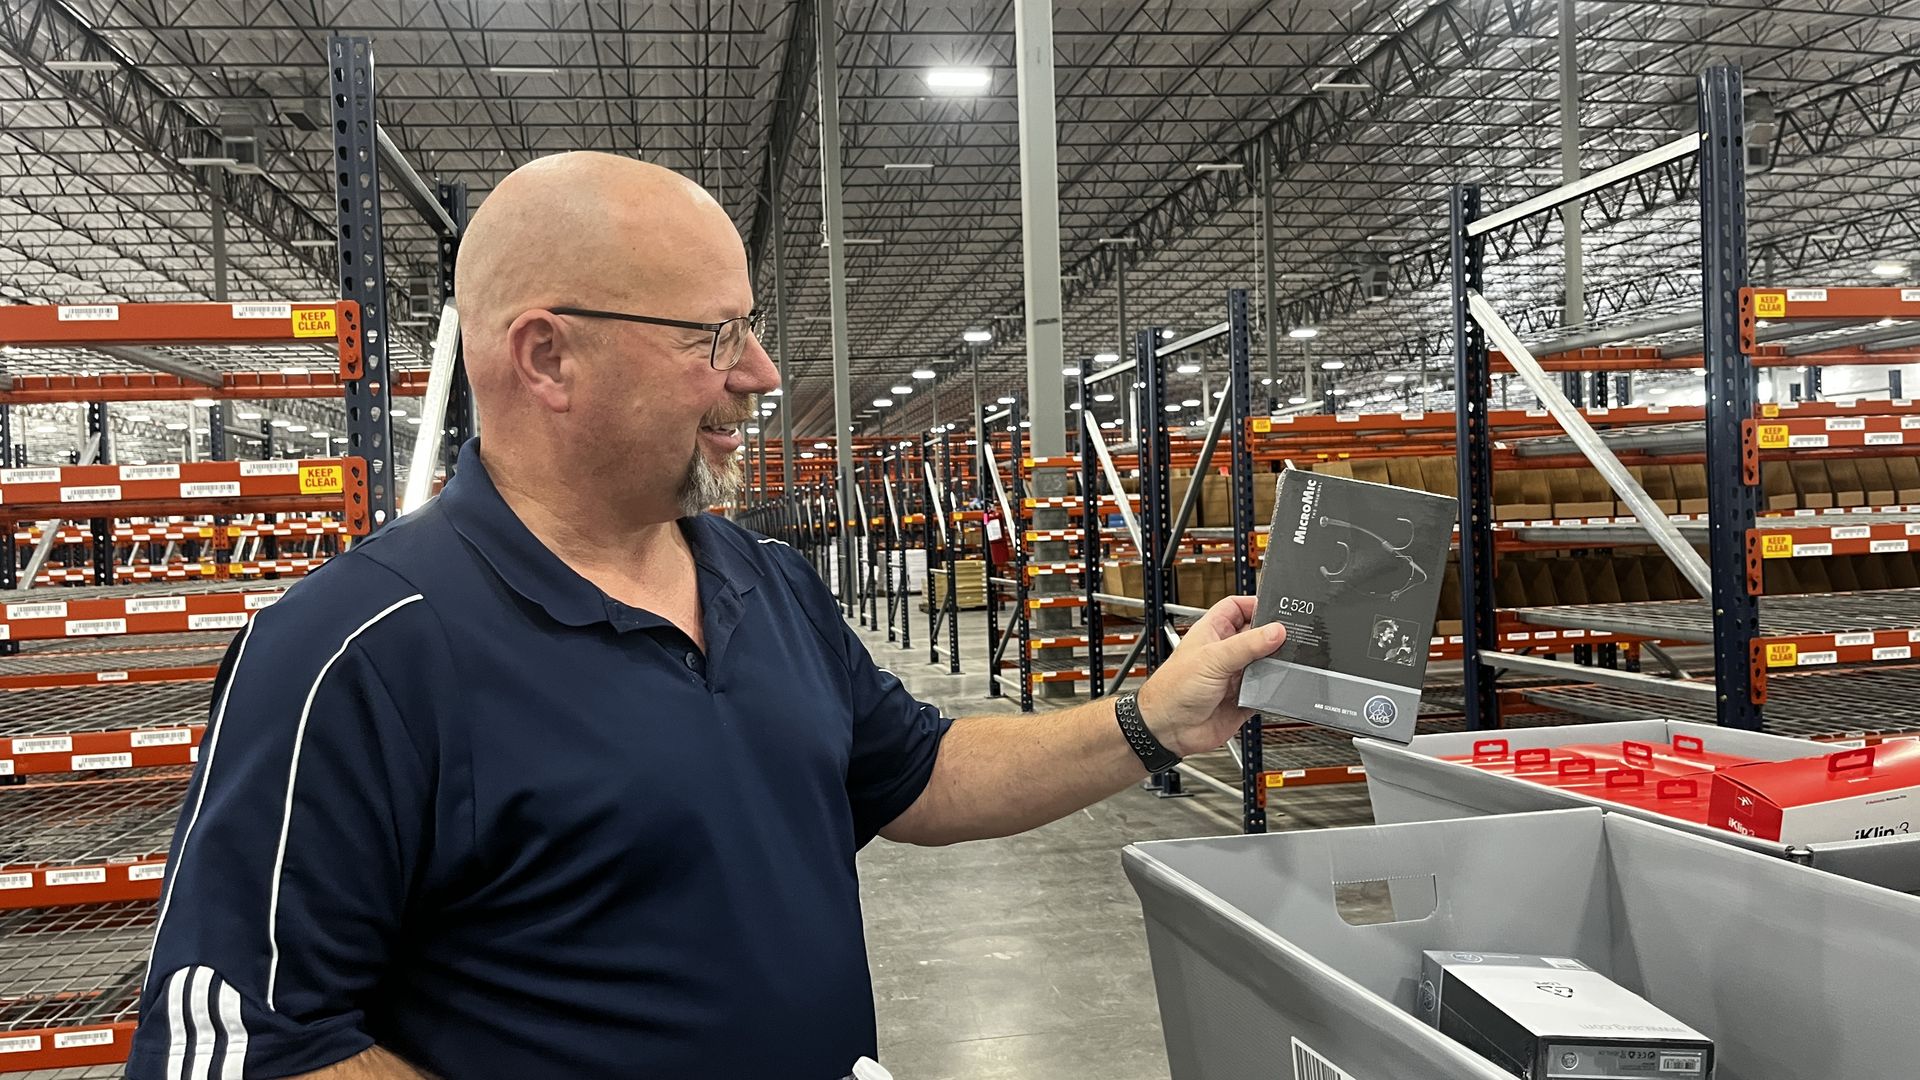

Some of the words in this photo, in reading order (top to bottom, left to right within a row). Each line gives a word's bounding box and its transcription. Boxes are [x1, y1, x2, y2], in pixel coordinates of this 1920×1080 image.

[1758, 303, 1782, 311] CLEAR
[300, 312, 326, 321] KEEP
[298, 321, 331, 331] CLEAR
[1762, 435, 1785, 443] CLEAR
[307, 468, 334, 477] KEEP
[305, 477, 337, 487] CLEAR
[1768, 536, 1786, 544] KEEP
[1766, 544, 1789, 553] CLEAR
[1279, 596, 1289, 610] C
[1290, 599, 1315, 615] 520
[1772, 645, 1790, 653] KEEP
[1770, 653, 1793, 661] CLEAR
[1368, 713, 1390, 724] AKG
[1728, 816, 1748, 835] iKlip
